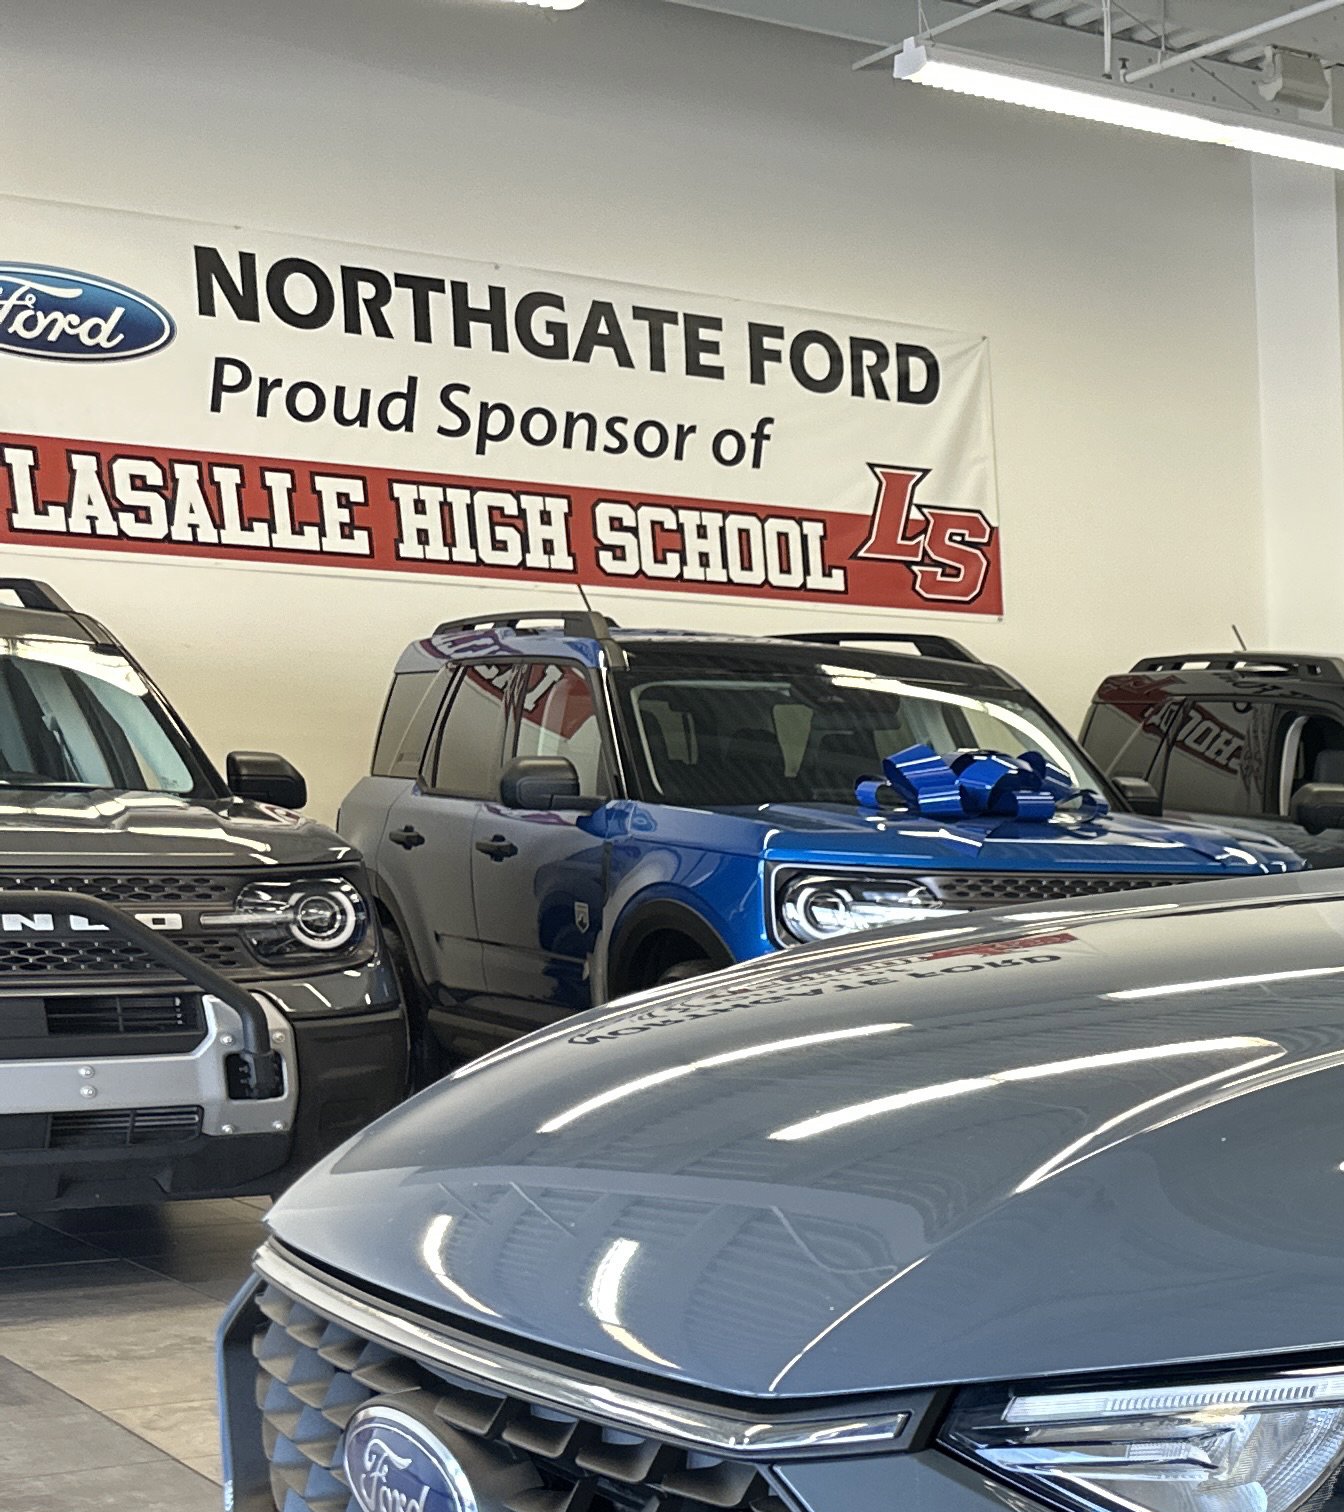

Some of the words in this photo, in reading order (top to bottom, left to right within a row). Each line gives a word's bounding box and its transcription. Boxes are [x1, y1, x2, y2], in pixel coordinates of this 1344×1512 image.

[193, 244, 726, 382] NORTHGATE
[747, 320, 941, 405] FORD
[210, 356, 419, 434] Proud
[436, 382, 697, 457] Sponsor
[711, 418, 776, 471] of
[3, 446, 371, 557] LASALLE
[392, 481, 575, 571] HIGH
[595, 502, 846, 593] SCHOOL
[849, 462, 995, 606] LS
